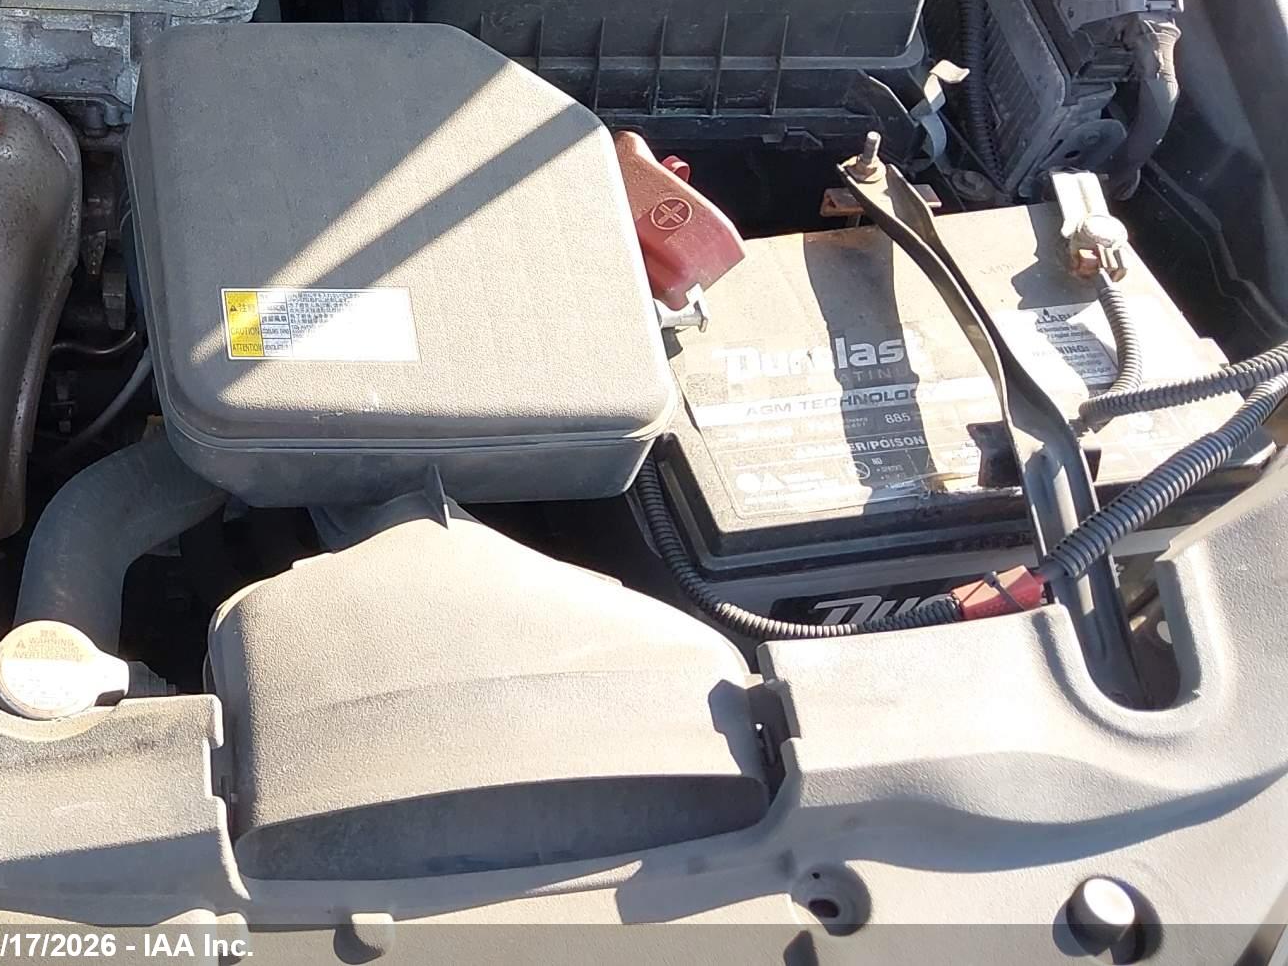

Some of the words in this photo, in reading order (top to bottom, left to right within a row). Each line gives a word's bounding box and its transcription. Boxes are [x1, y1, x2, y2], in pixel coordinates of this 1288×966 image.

[717, 333, 922, 379] Durlas
[746, 401, 792, 418] AGM
[883, 410, 913, 425] 885
